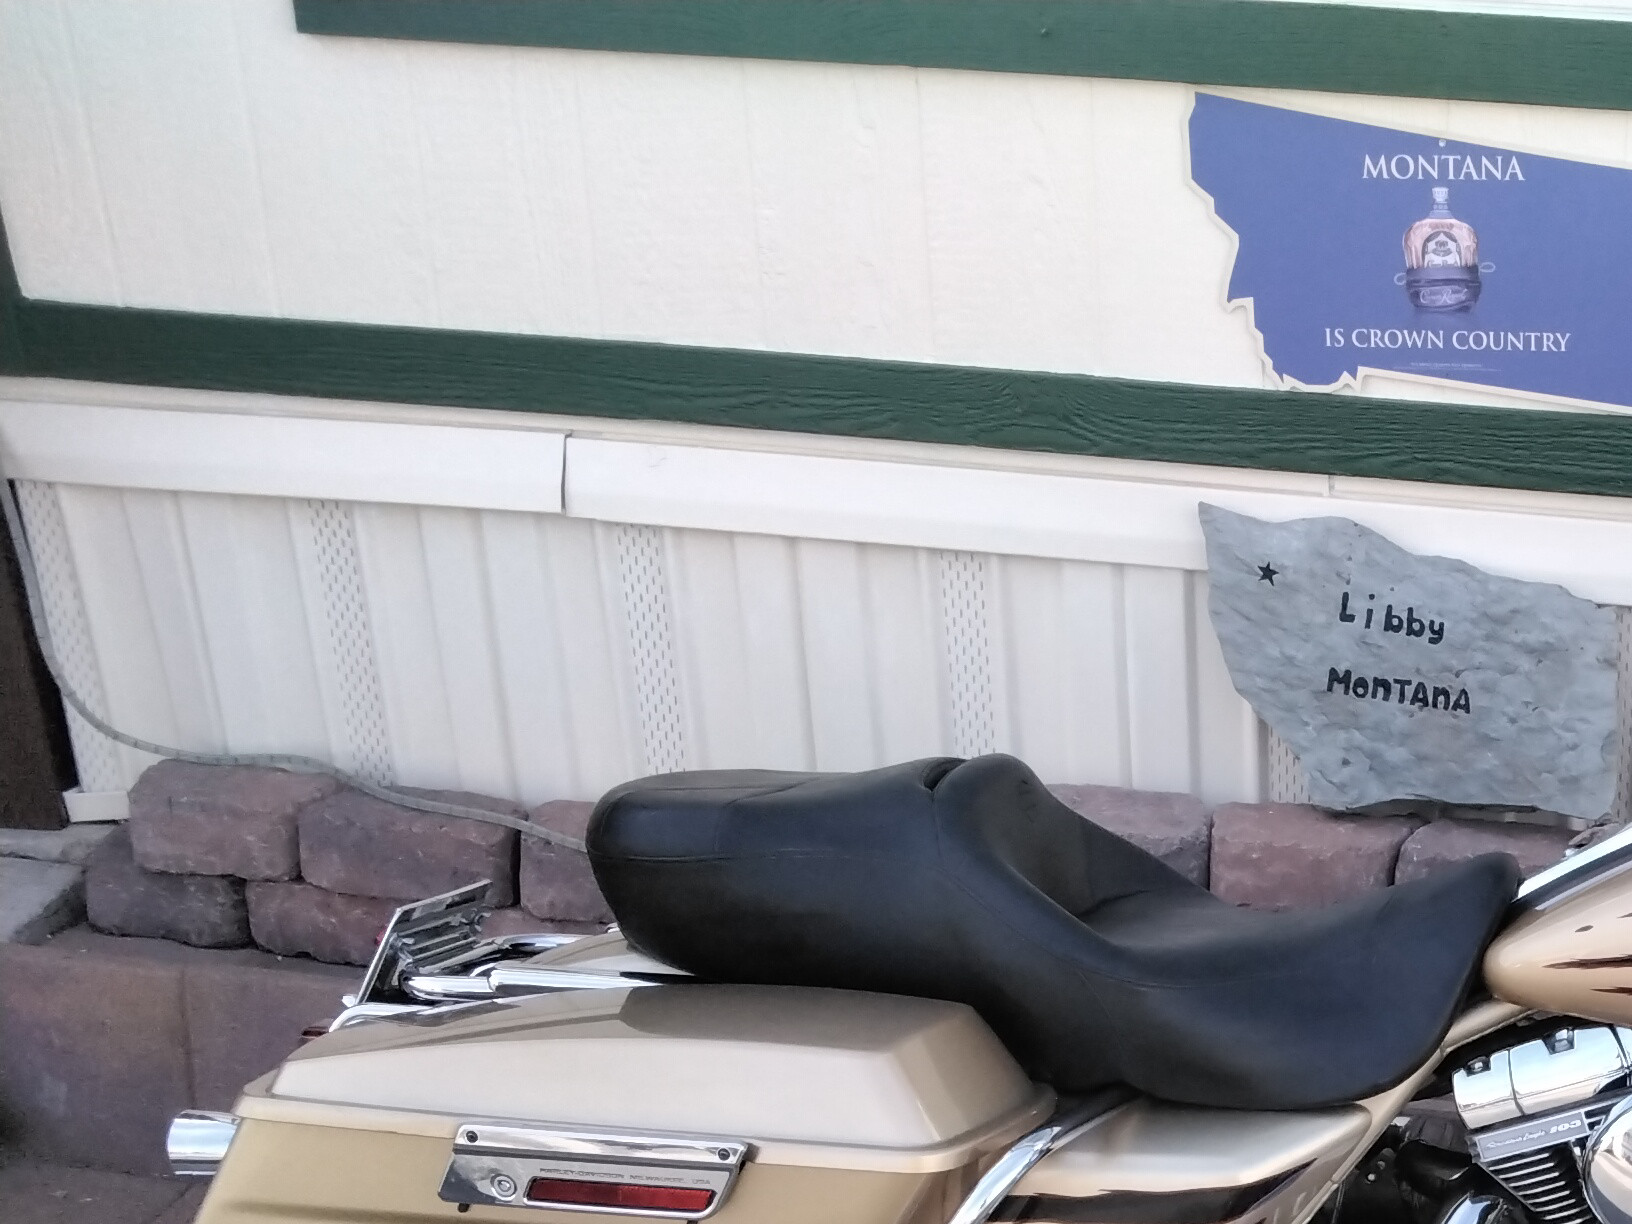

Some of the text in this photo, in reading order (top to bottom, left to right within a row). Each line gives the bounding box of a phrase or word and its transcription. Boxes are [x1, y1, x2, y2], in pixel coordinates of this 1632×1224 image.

[1362, 153, 1526, 181] MONTANA
[1325, 327, 1571, 352] IS CROWN COUNTRY
[1339, 591, 1445, 645] Libby
[1550, 1119, 1582, 1134] 103
